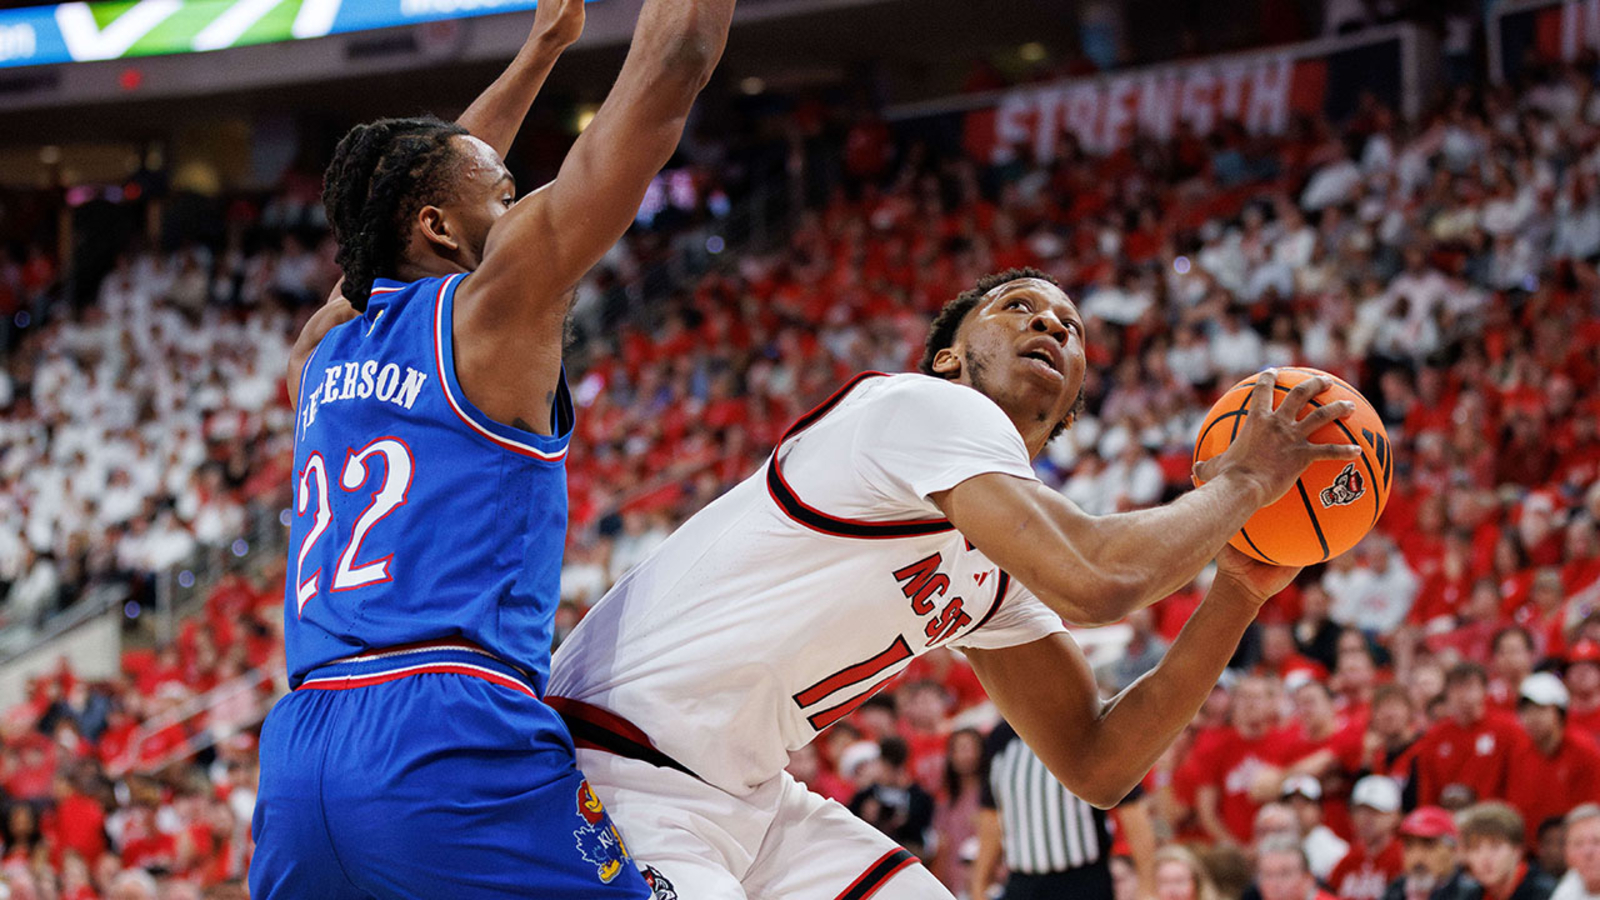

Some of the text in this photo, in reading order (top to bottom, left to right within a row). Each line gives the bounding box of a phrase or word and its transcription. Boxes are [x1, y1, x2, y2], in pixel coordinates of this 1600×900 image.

[992, 57, 1293, 162] STRENGTH
[296, 436, 415, 620] 22
[892, 551, 950, 616] NC
